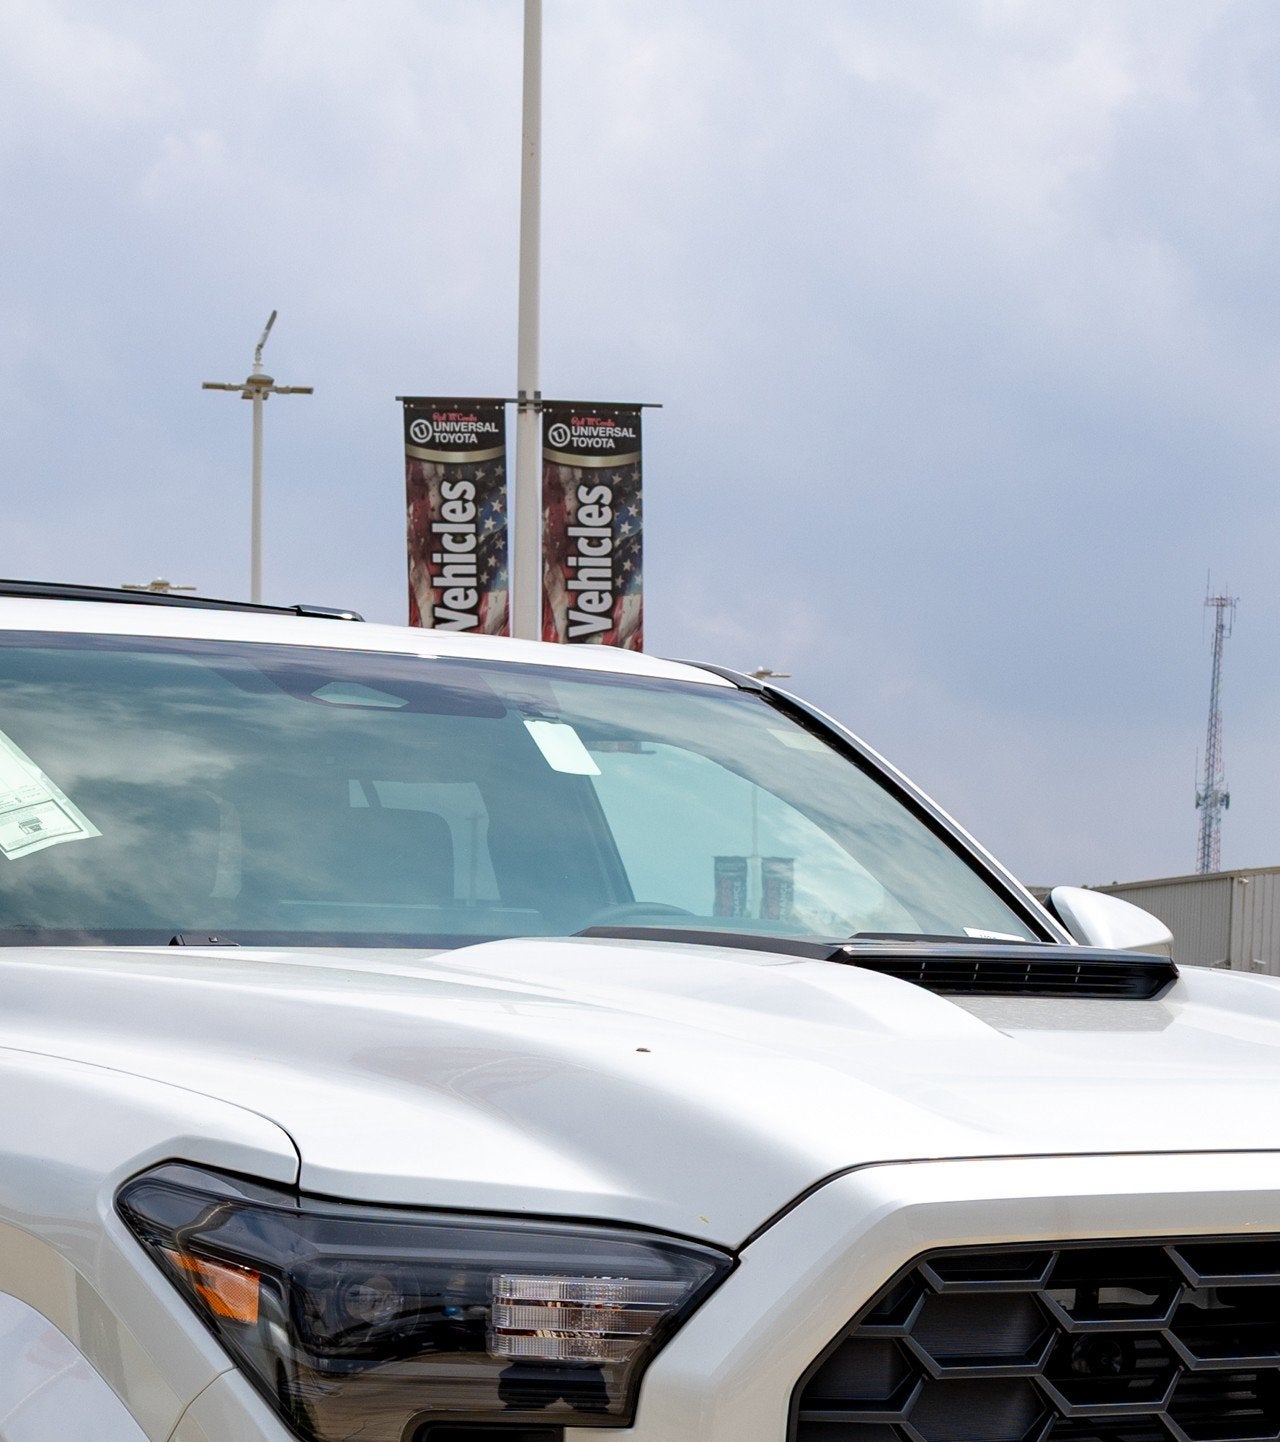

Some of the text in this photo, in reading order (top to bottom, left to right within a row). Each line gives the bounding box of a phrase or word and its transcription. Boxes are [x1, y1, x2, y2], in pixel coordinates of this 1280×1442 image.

[433, 421, 499, 433] UNIVERSAL
[571, 426, 636, 437] UNIVERSAL
[433, 433, 478, 443] TOYOTA
[571, 437, 615, 448] TOYOTA
[431, 480, 479, 631] Vehicles
[568, 485, 613, 637] Vehicles
